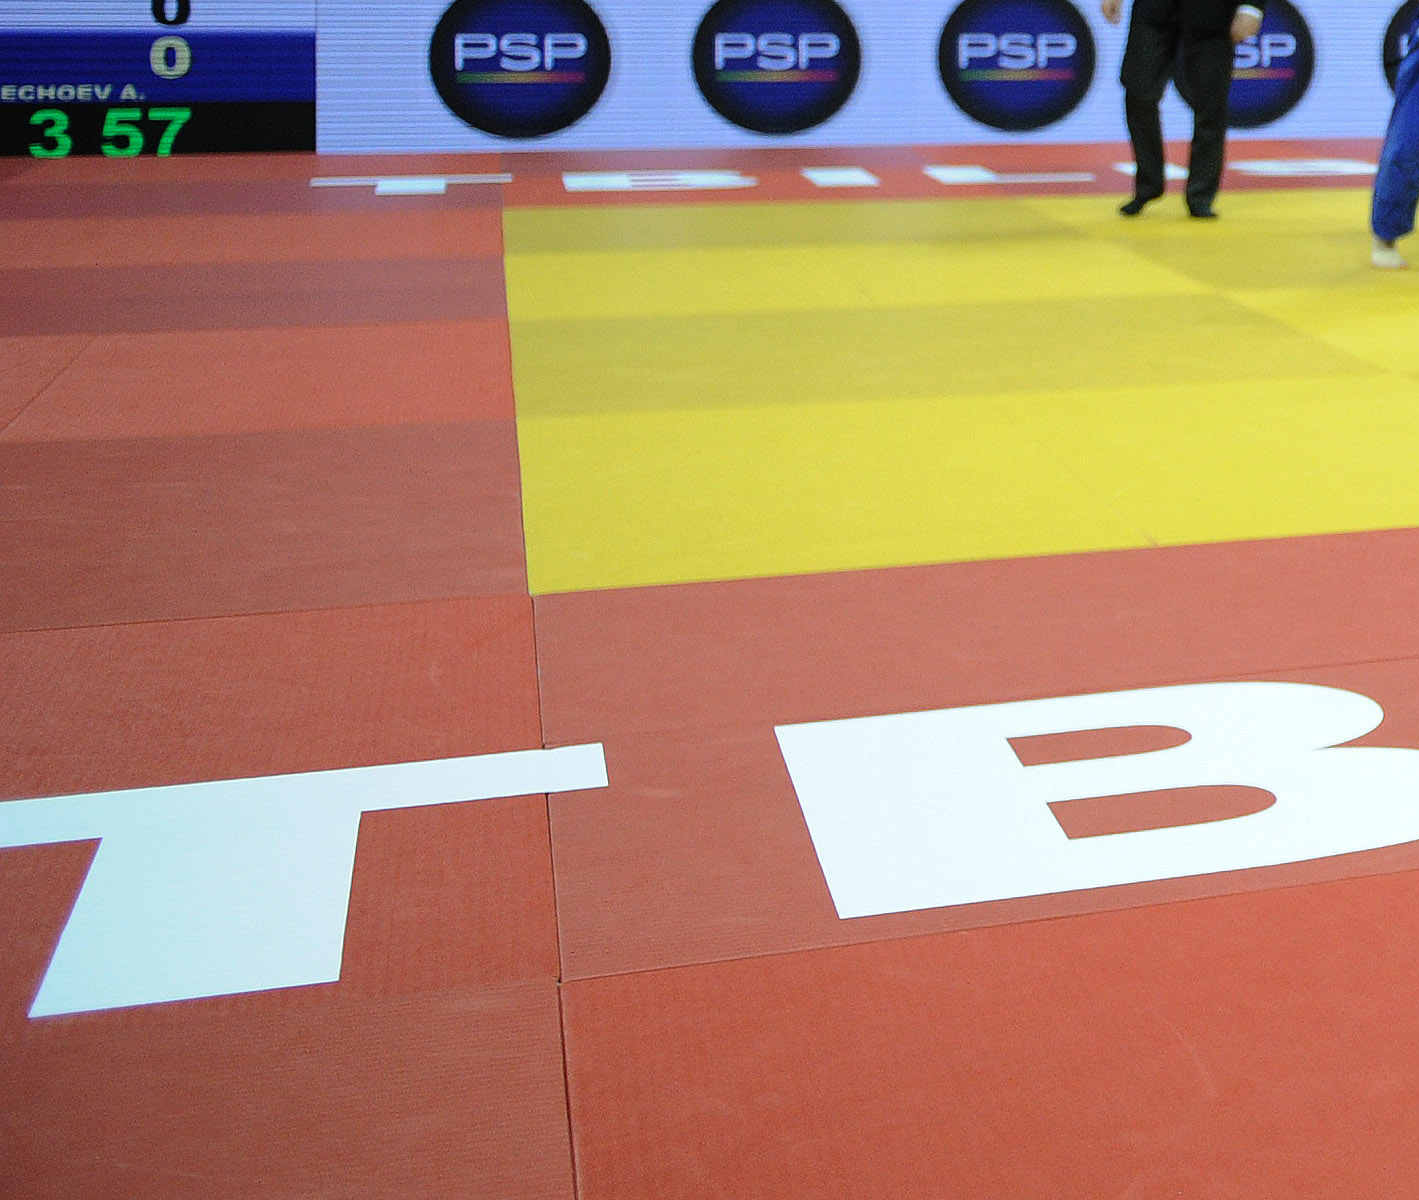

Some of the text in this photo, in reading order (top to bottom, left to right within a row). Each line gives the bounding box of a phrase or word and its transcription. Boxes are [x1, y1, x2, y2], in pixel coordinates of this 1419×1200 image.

[149, 36, 193, 80] 0
[454, 32, 588, 71] PSP
[714, 31, 839, 70] PSP
[957, 32, 1077, 69] PSP
[119, 83, 146, 101] A.
[28, 106, 193, 159] 3 57
